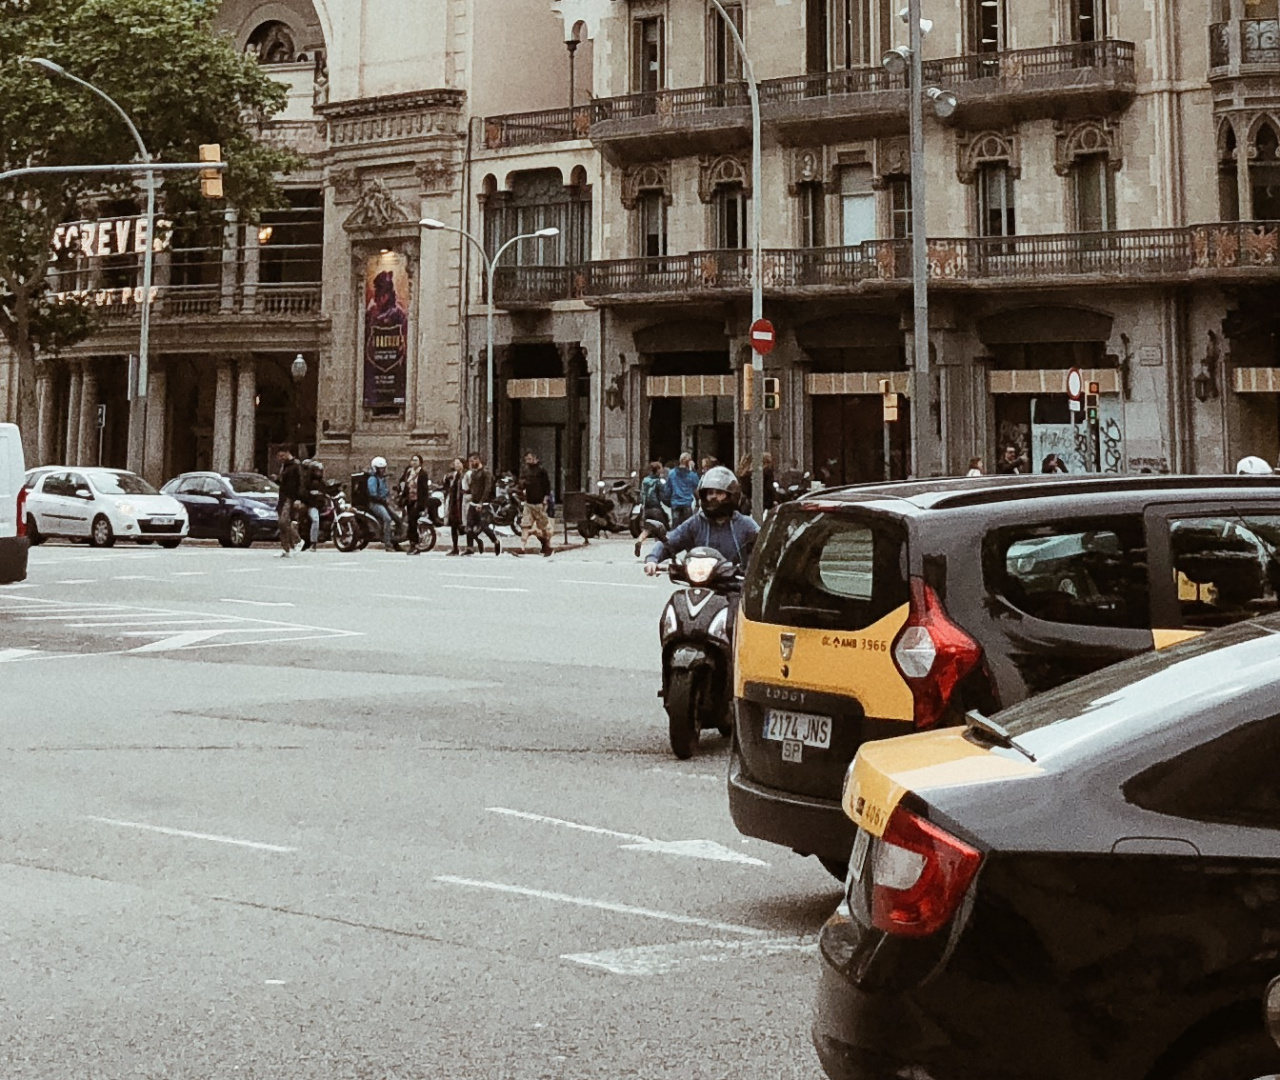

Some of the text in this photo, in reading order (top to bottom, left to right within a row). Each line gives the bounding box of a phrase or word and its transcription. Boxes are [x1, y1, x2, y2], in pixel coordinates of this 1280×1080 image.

[861, 639, 887, 652] 3966
[766, 687, 806, 704] LODGY
[770, 714, 828, 744] 2174 JNS
[783, 741, 800, 759] SP
